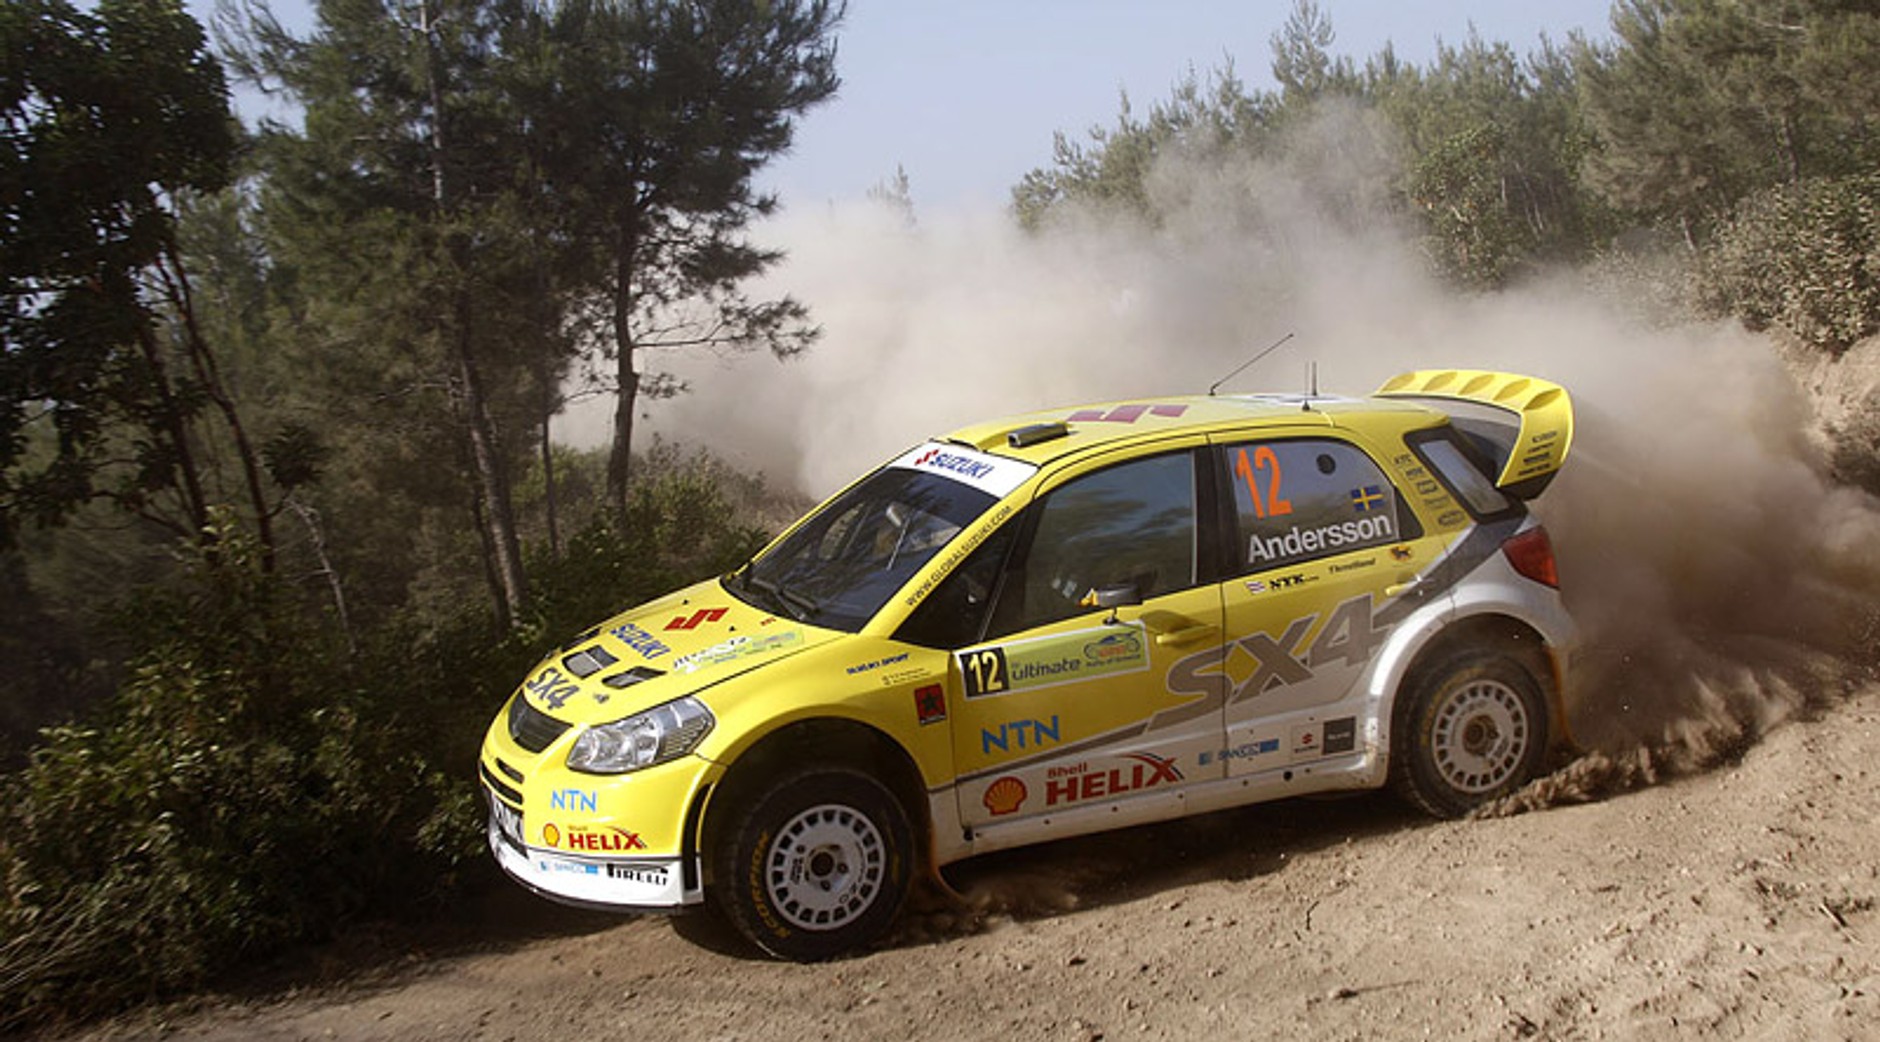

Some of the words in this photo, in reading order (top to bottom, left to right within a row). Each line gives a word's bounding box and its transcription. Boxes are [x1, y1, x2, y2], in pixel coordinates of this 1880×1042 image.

[928, 453, 995, 479] SUZUKI
[1235, 445, 1293, 519] 12
[905, 505, 1013, 606] WWW.GLOBALSUZUKI.COM
[1247, 513, 1393, 563] Andersson
[609, 623, 671, 660] SUZUKI
[969, 650, 1003, 694] 12
[1012, 657, 1081, 681] ultimate
[1147, 592, 1393, 733] SX4
[526, 667, 580, 711] SX4
[979, 714, 1062, 754] NTN
[1046, 754, 1184, 807] HELIX
[1047, 761, 1088, 779] Shell
[550, 789, 597, 813] NTN
[567, 826, 646, 851] HELIX
[605, 863, 669, 887] PIRELLI
